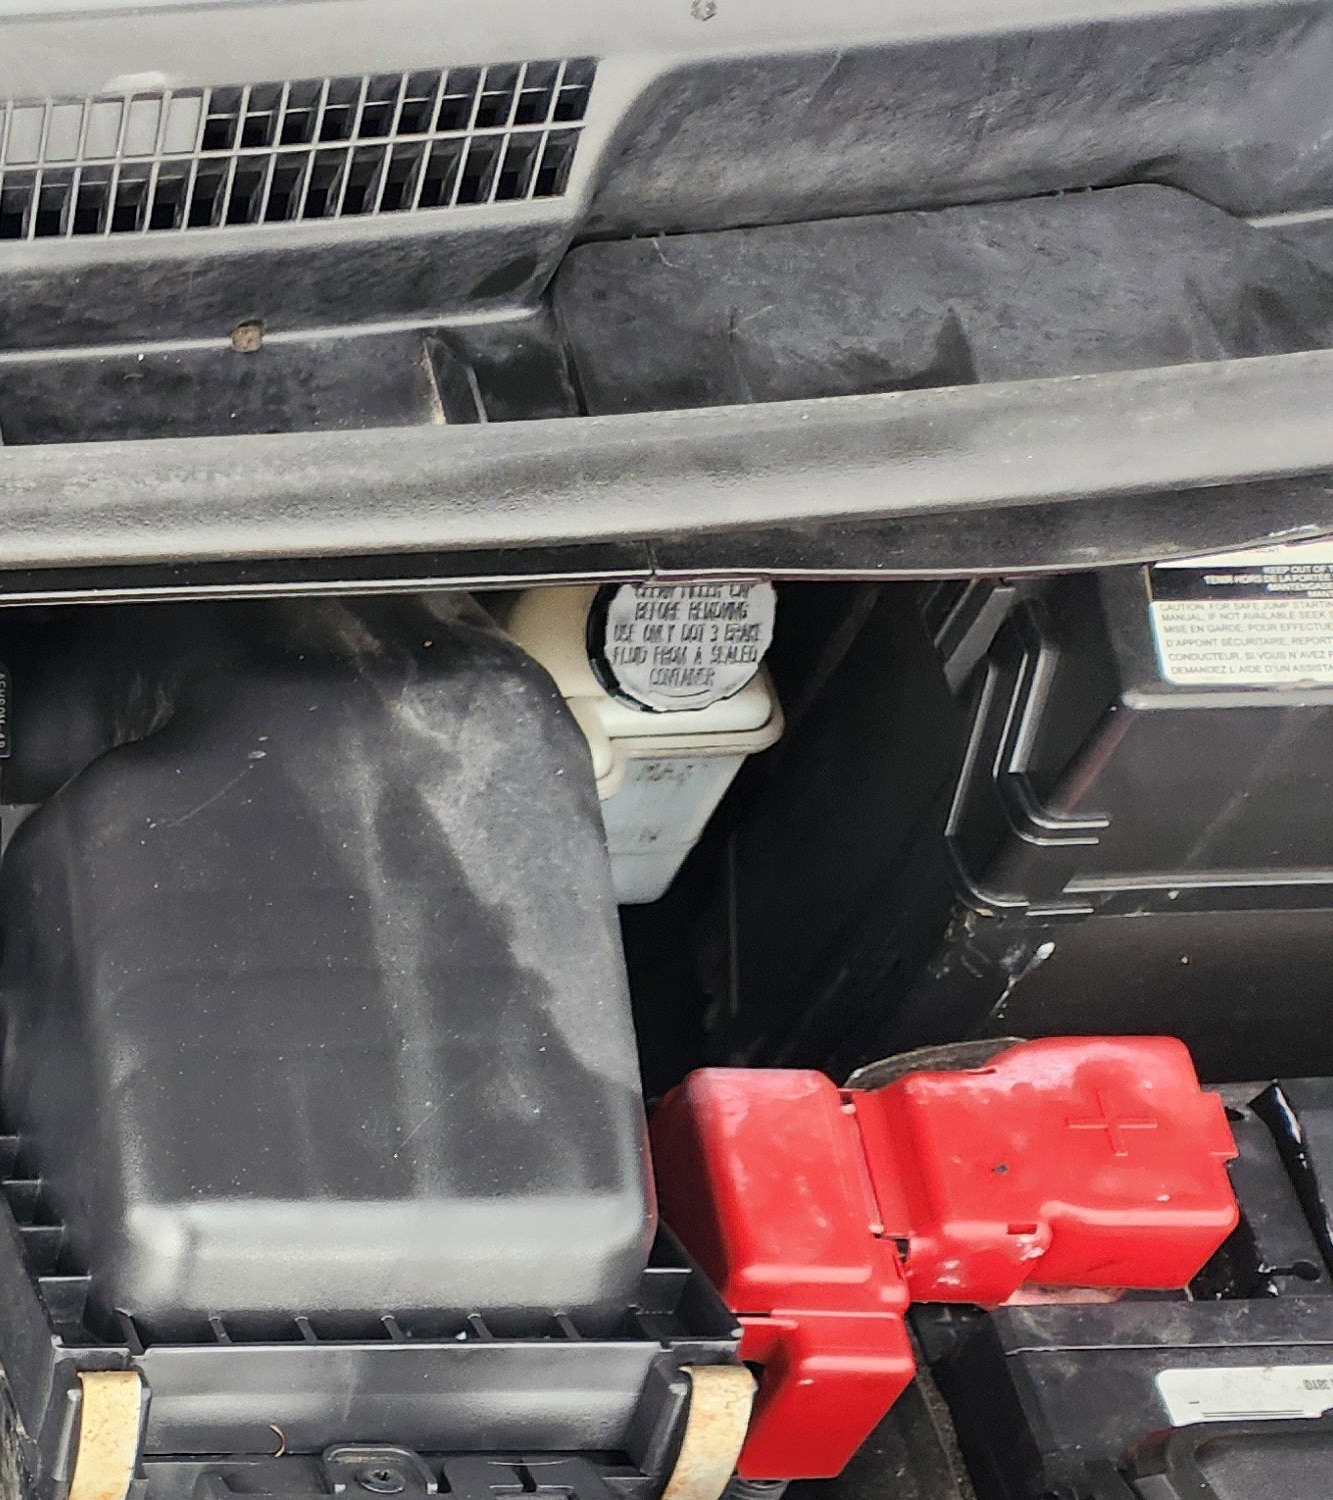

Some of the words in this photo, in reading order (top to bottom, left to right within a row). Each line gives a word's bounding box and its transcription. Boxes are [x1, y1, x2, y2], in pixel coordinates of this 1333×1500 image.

[1291, 566, 1311, 574] OUT
[681, 623, 706, 643] DOT
[710, 623, 719, 643] 3
[692, 646, 703, 665] A
[710, 645, 758, 665] SEALED
